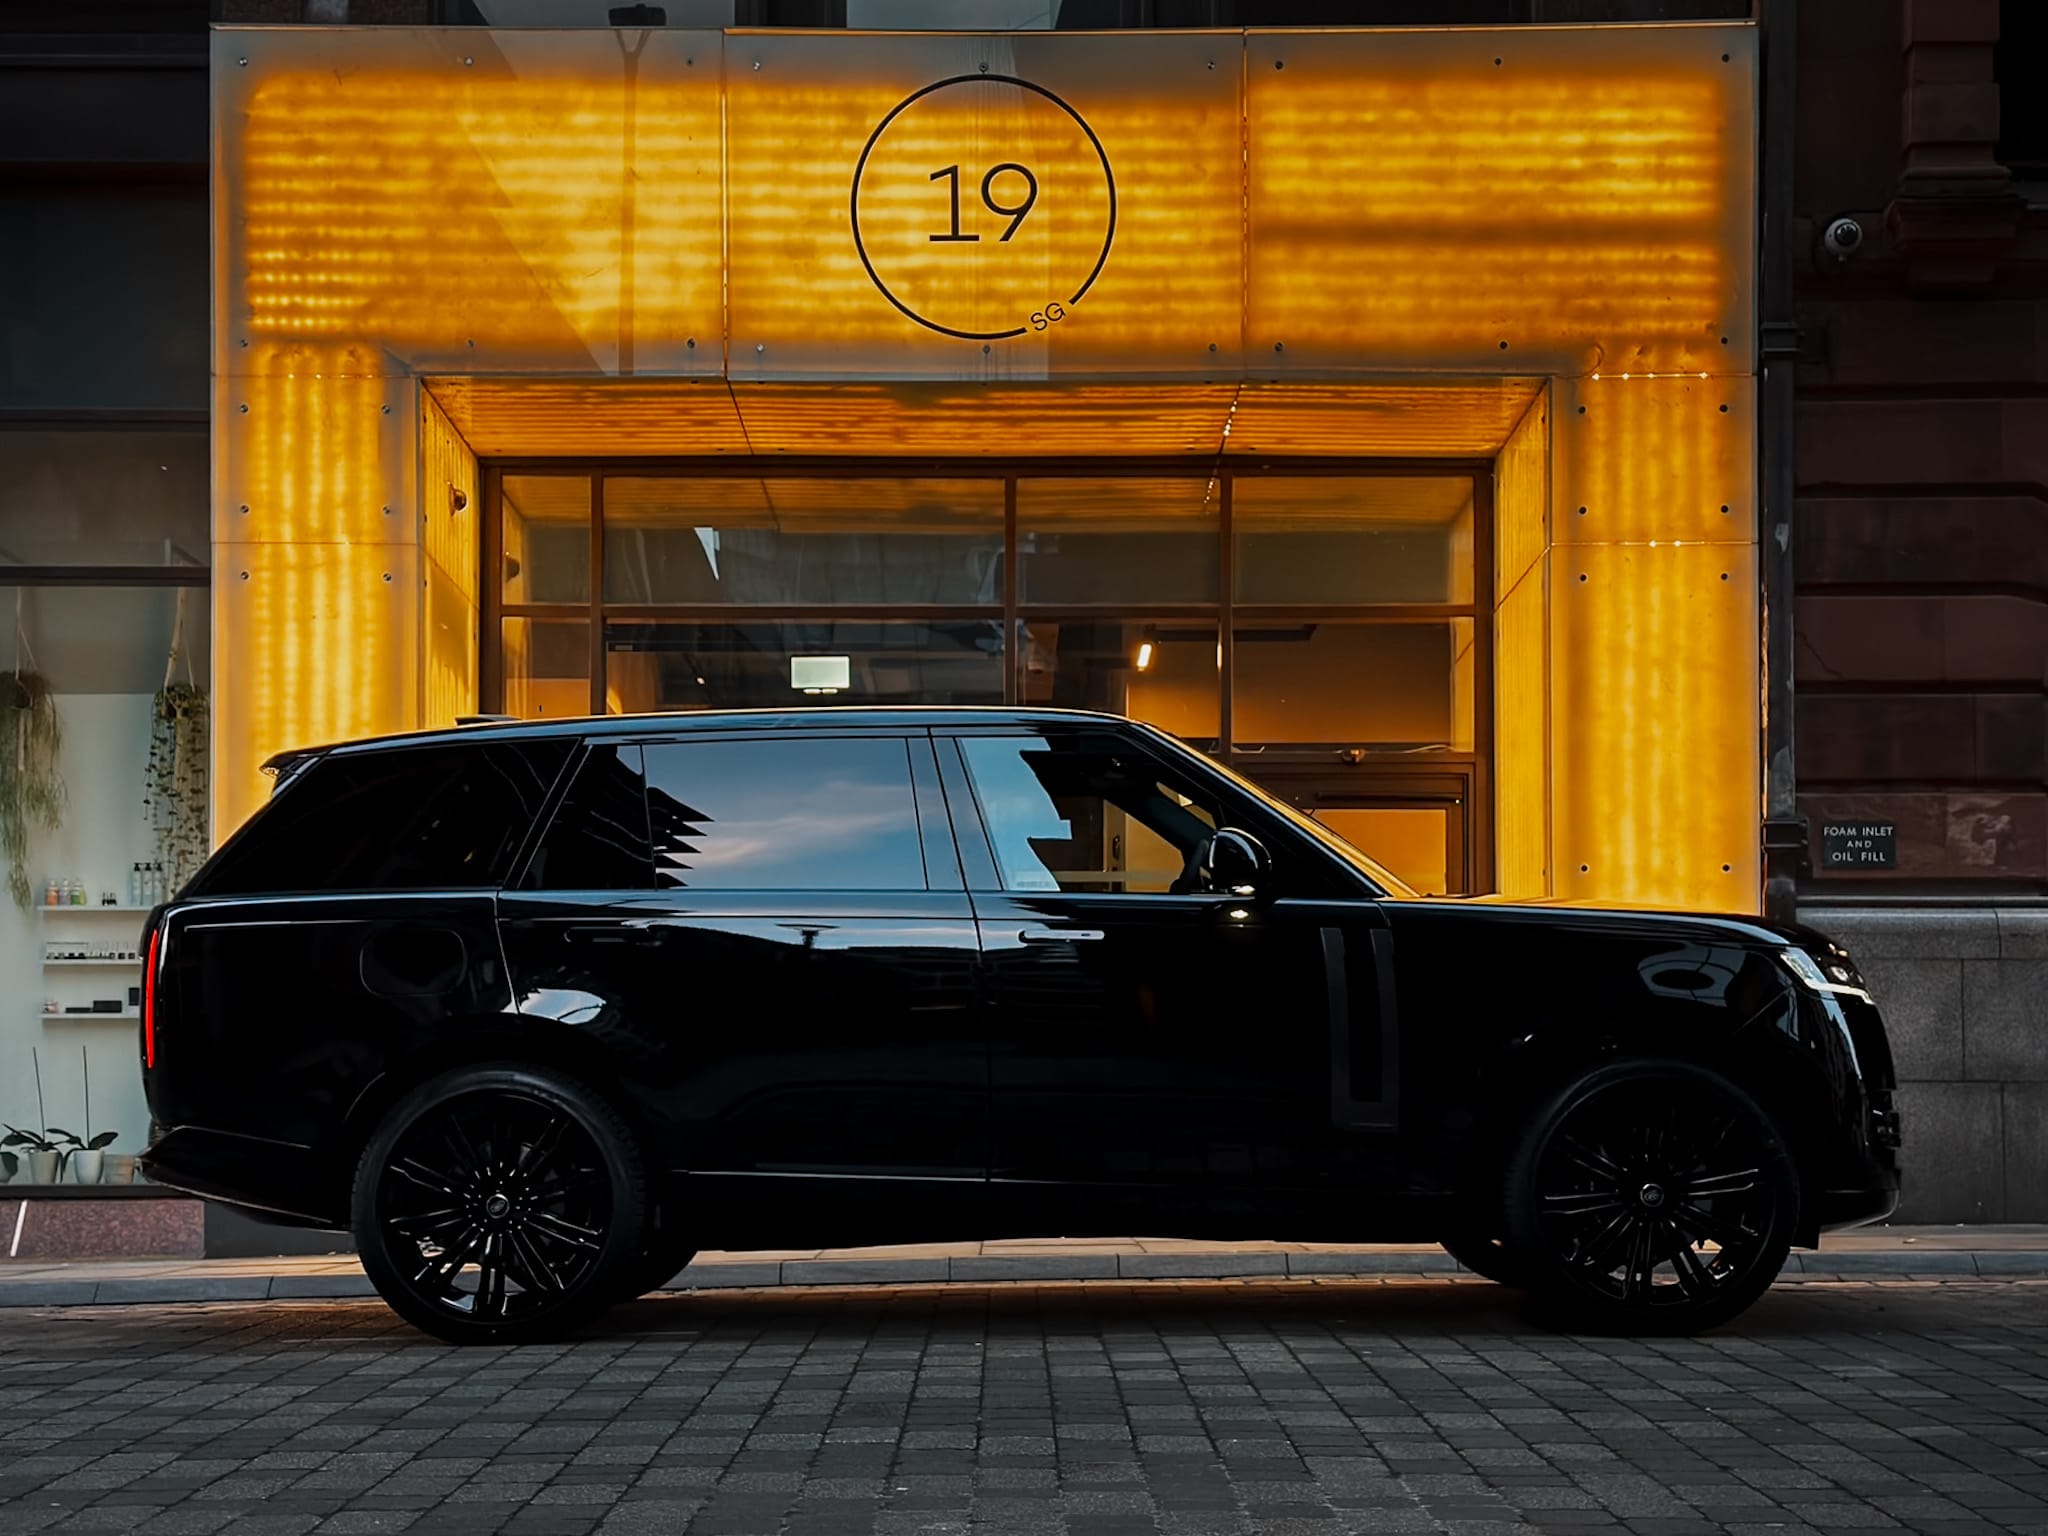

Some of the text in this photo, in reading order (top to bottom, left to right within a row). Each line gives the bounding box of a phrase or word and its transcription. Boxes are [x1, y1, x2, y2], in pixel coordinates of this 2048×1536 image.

[929, 163, 1038, 242] 19
[1030, 302, 1066, 331] SG
[1823, 826, 1893, 836] FOAM INLET
[1847, 840, 1872, 848] AND
[1832, 851, 1886, 862] OIL FILL
